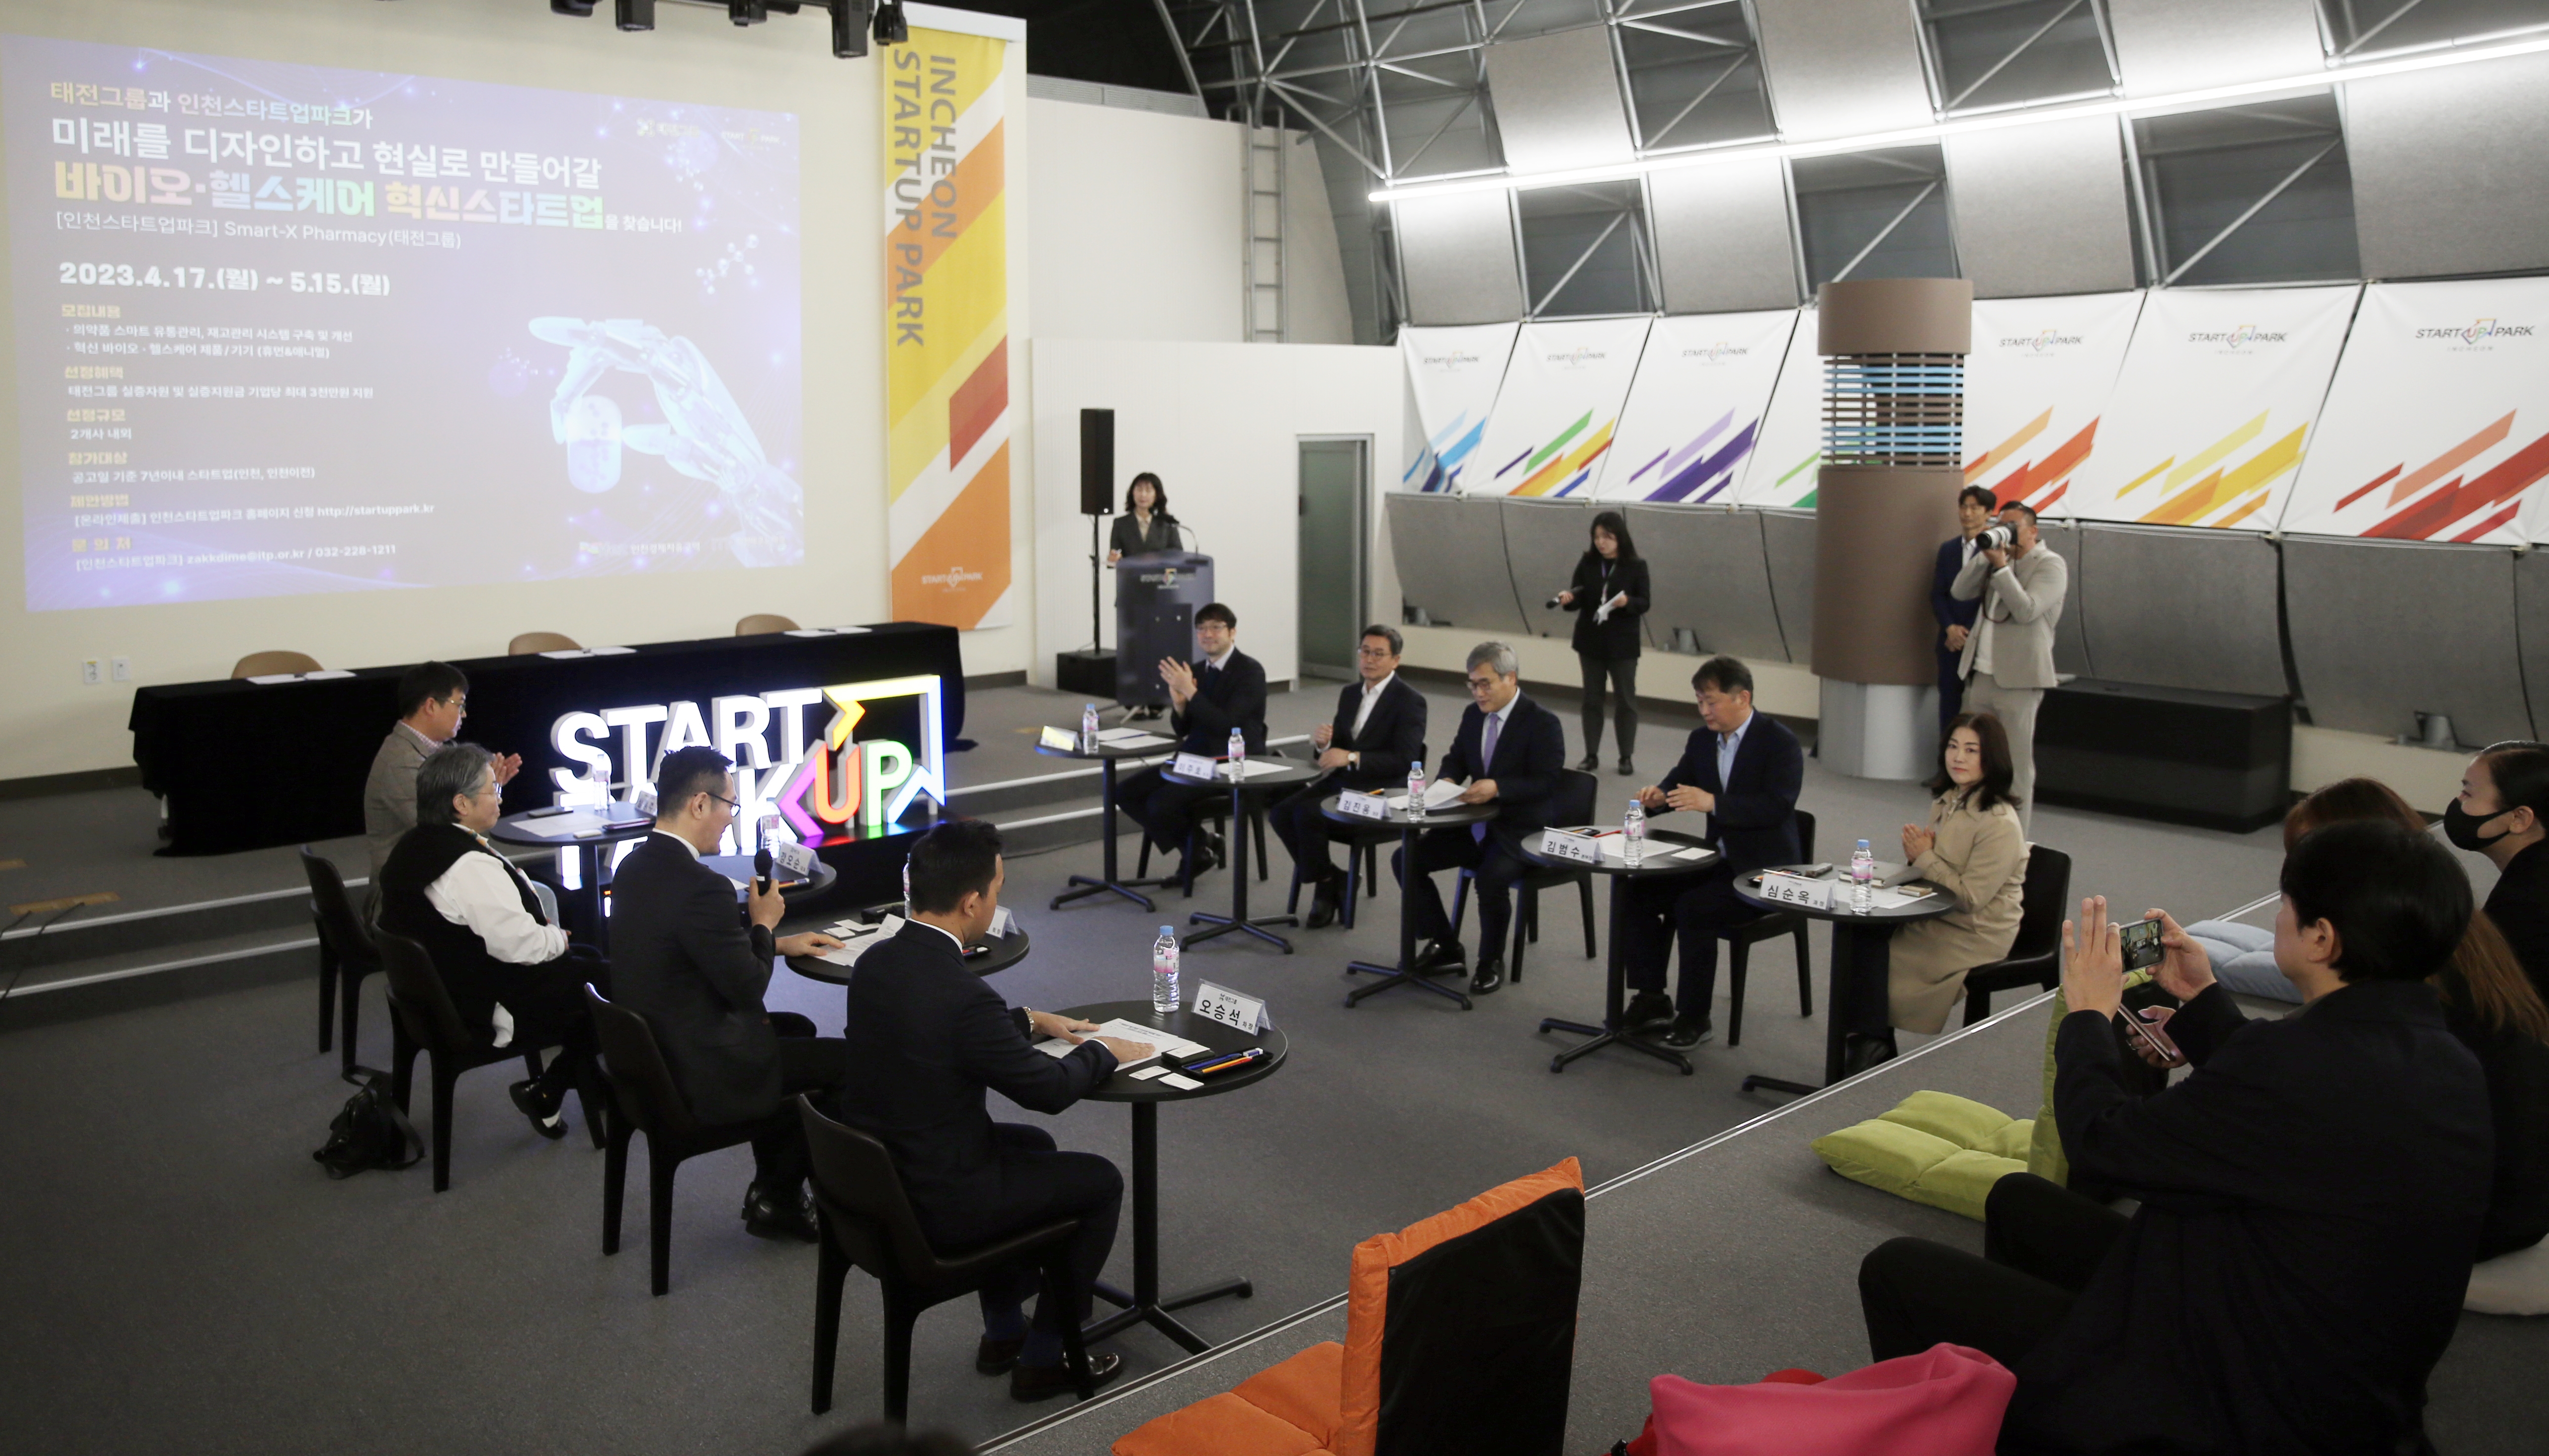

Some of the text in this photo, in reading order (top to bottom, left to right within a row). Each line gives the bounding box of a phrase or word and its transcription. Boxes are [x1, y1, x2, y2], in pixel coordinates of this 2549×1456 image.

[50, 81, 373, 129] 태전그룹과 인천스타트업파크가
[53, 117, 602, 189] 미래를 디자인하고 현실로 만들어갈
[930, 55, 957, 239] INCHEON
[55, 161, 375, 217] 바이오·헬스케어
[623, 215, 682, 234] 찾습니다!
[894, 49, 924, 347] STARTUP PARK
[56, 212, 460, 250] [인천스타트업파크] Smart-X Pharmacy(태전그룹)
[60, 262, 259, 291] 2023.4.17.(월)
[291, 272, 390, 297] 5.15.(월)
[62, 304, 121, 318] 모집내용
[74, 324, 353, 343] 의약품 스마트 유통관리, 재고관리 시스템 구축 및 개선
[2188, 332, 2228, 342] START
[2254, 332, 2289, 342] PARK
[2416, 327, 2463, 339] START
[2495, 325, 2536, 337] PARK
[74, 341, 99, 355] 혁신
[102, 342, 139, 355] 바이오
[149, 343, 197, 356] 헬스케어
[65, 366, 123, 379] 선정혜택
[68, 385, 118, 398] 태전그룹
[173, 386, 184, 398] 및
[67, 409, 125, 422] 선정규모
[71, 428, 132, 440] 2개사 내외
[69, 451, 127, 466] 참가대상
[73, 471, 109, 484] 공고일
[113, 470, 137, 483] 기준
[140, 469, 184, 483] 7년이내
[150, 509, 243, 524] 인천스타트업파크
[247, 506, 289, 520] 홈페이지
[293, 506, 314, 519] 신청
[318, 503, 435, 518] http://startuppark.kr
[76, 554, 183, 572] [인천스타트업파크]
[315, 544, 396, 558] 032-228-1211
[554, 688, 823, 791] START
[1547, 841, 1580, 857] 김범수
[1768, 885, 1809, 904] 심순옥
[1200, 999, 1253, 1030] 오승석 차장
